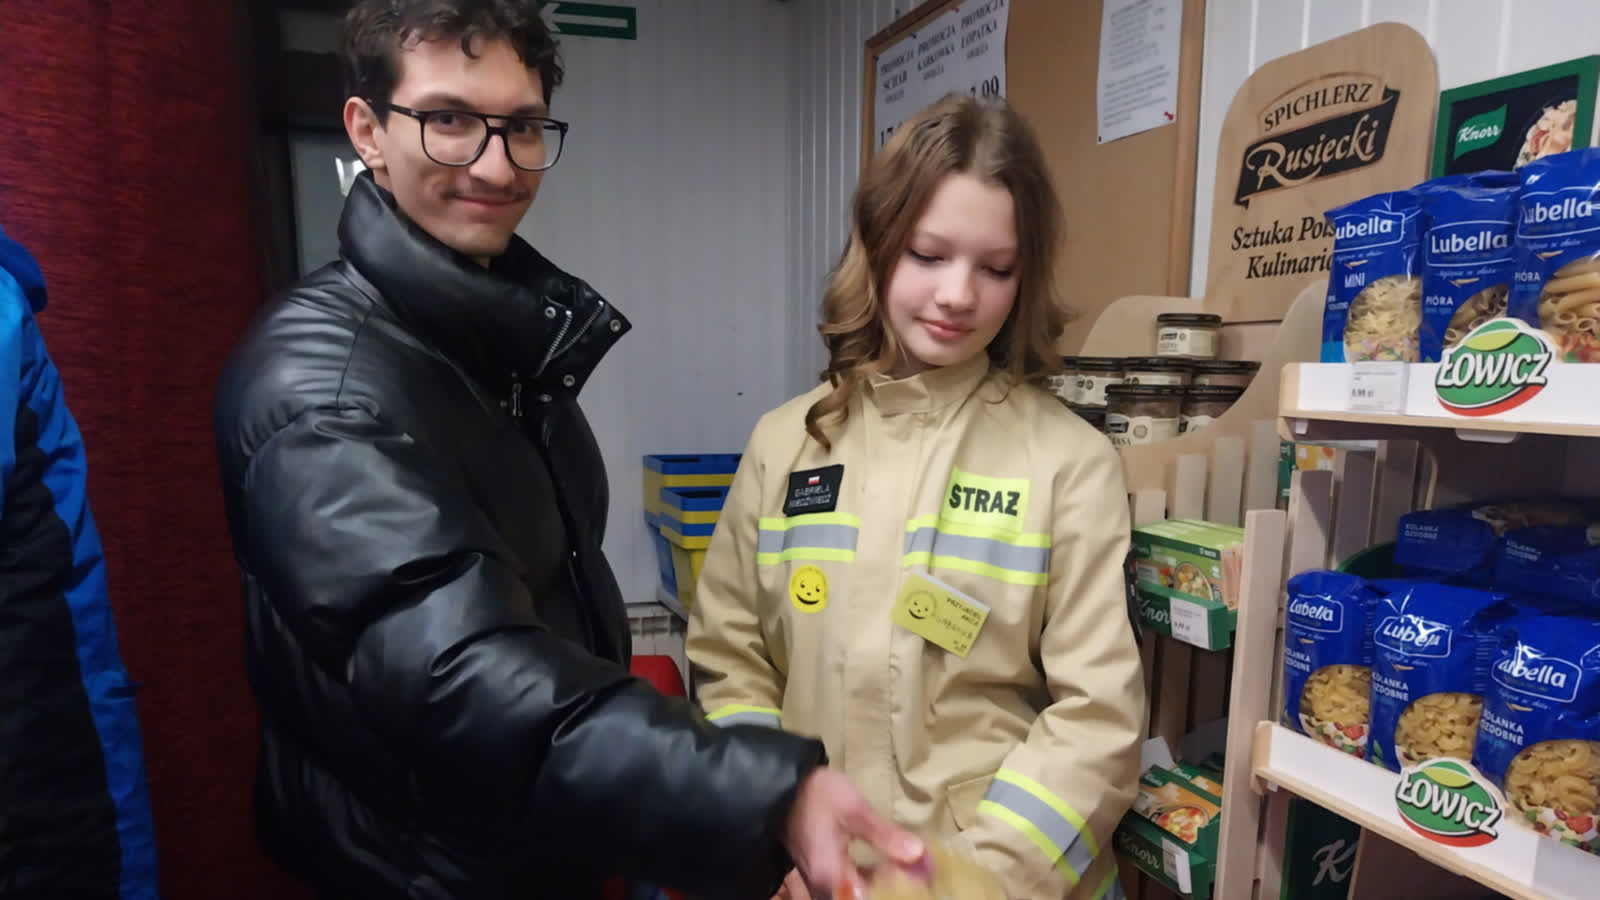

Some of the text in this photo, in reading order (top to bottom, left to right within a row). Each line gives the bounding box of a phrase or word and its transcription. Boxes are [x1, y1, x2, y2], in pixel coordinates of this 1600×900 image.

[1264, 83, 1374, 131] SPICHLERZ
[1458, 124, 1502, 143] Knorr
[1245, 112, 1379, 189] Rusiecki
[1231, 220, 1294, 251] Sztuka
[1335, 216, 1393, 240] ubella
[1431, 231, 1509, 254] Lubella
[1436, 352, 1551, 387] ŁOWICZ
[1289, 599, 1334, 622] Lubella
[1397, 770, 1502, 838] ŁOWICZ
